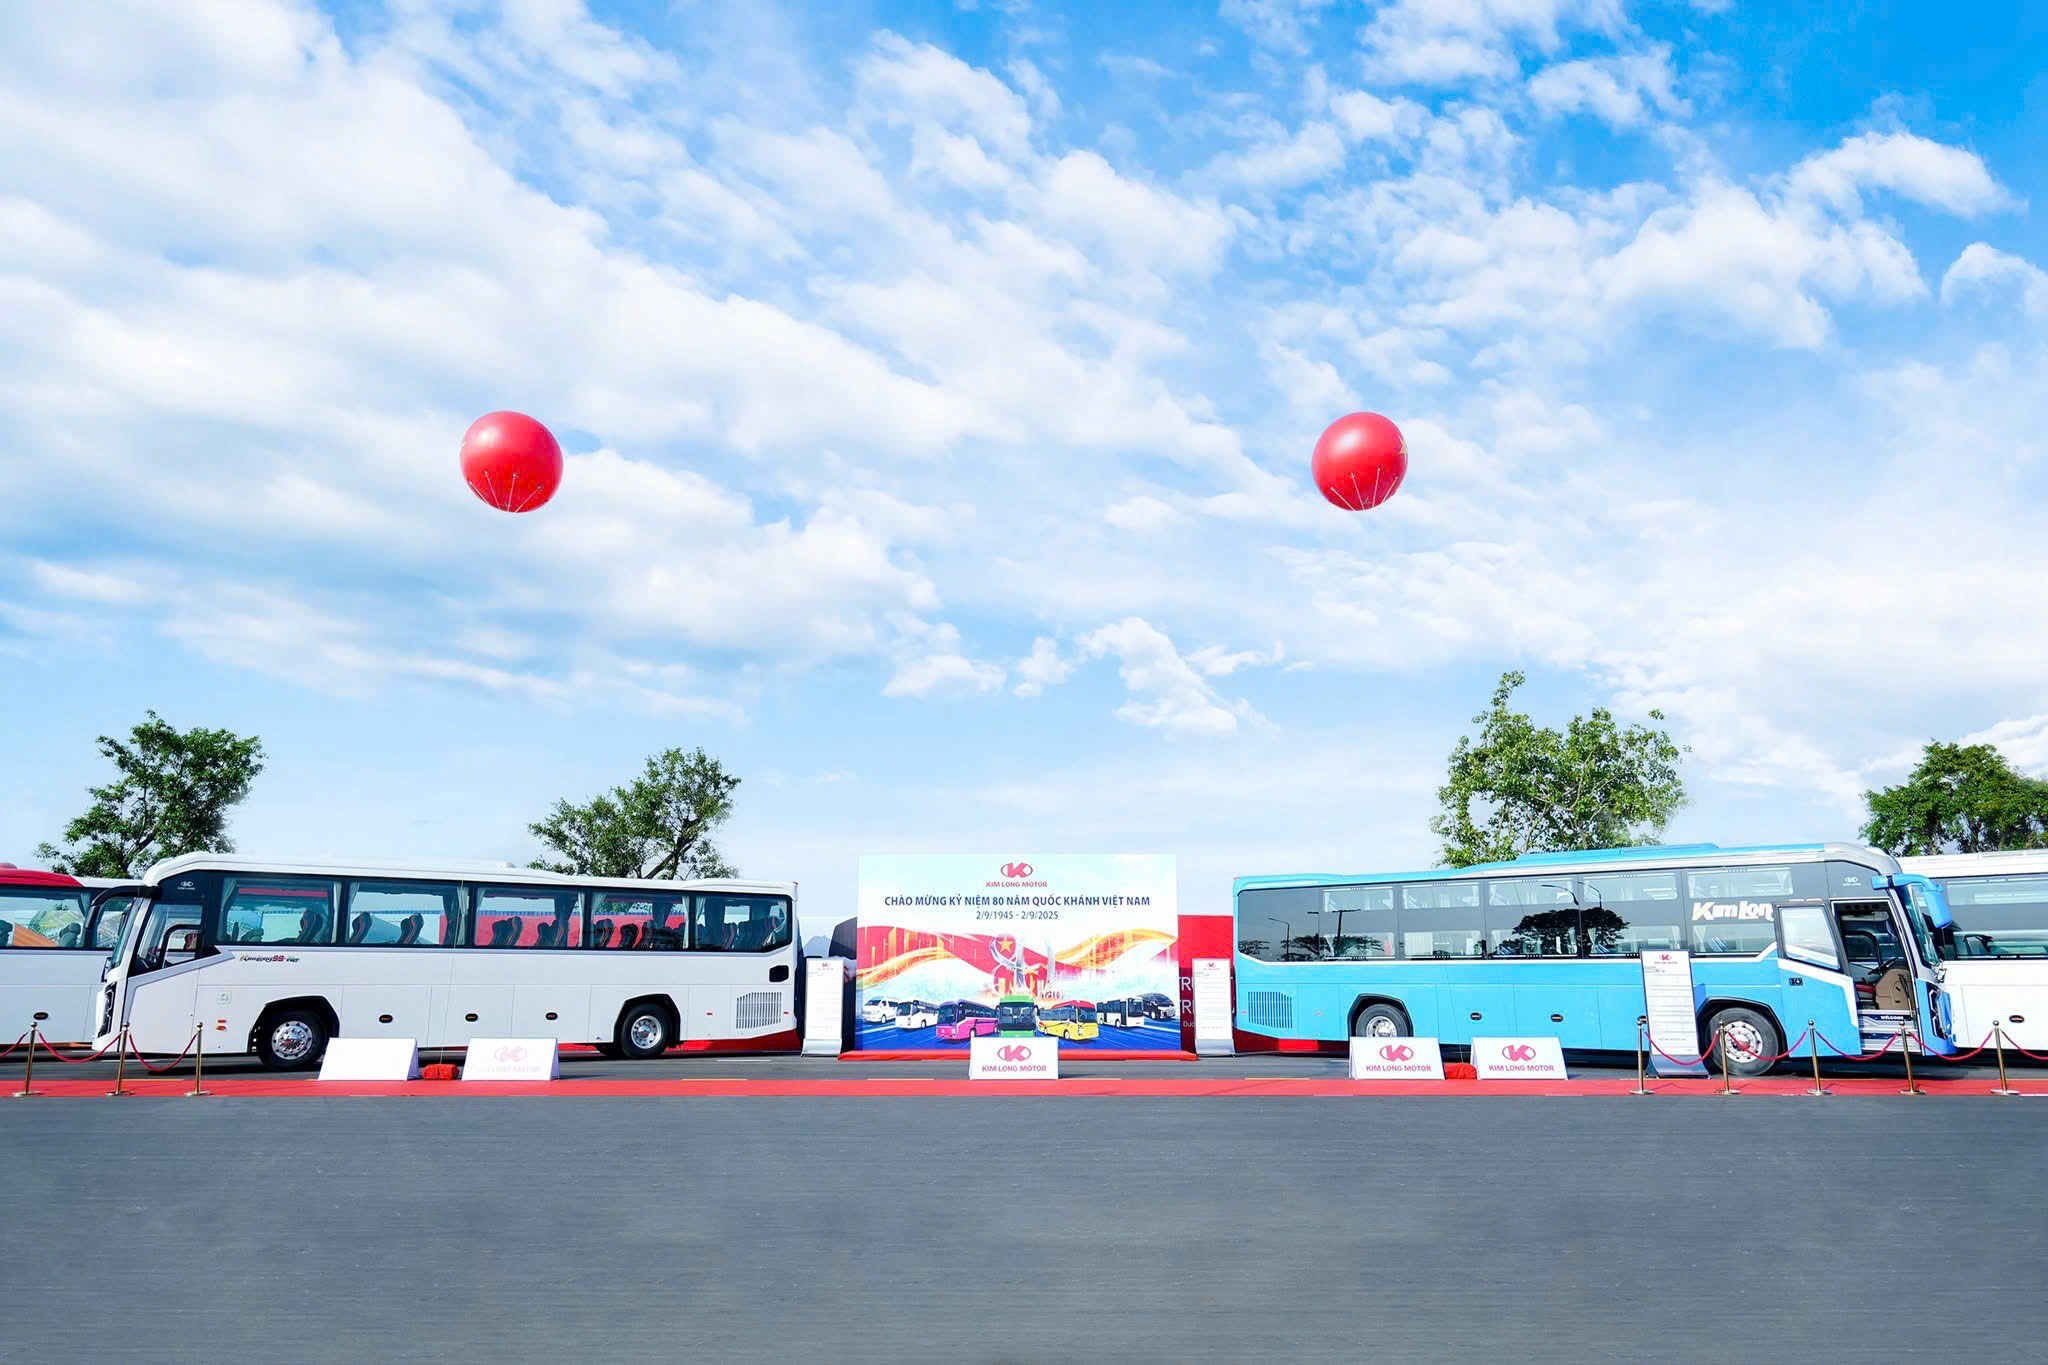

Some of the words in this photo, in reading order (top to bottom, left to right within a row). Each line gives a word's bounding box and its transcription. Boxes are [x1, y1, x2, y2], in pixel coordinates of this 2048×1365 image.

[884, 893, 913, 906] CHÀO
[915, 893, 947, 906] MỪNG
[964, 894, 990, 909] NIỆM
[992, 896, 1004, 906] 80
[1006, 894, 1030, 906] NĂM
[1032, 892, 1062, 907] QUỐC
[1063, 893, 1100, 906] KHÁNH
[1101, 894, 1124, 909] VIỆT
[1126, 896, 1150, 906] NAM
[976, 910, 1014, 920] 2/9/1945
[1021, 910, 1059, 920] 2/9/2025
[1527, 1064, 1554, 1072] MOTOR
